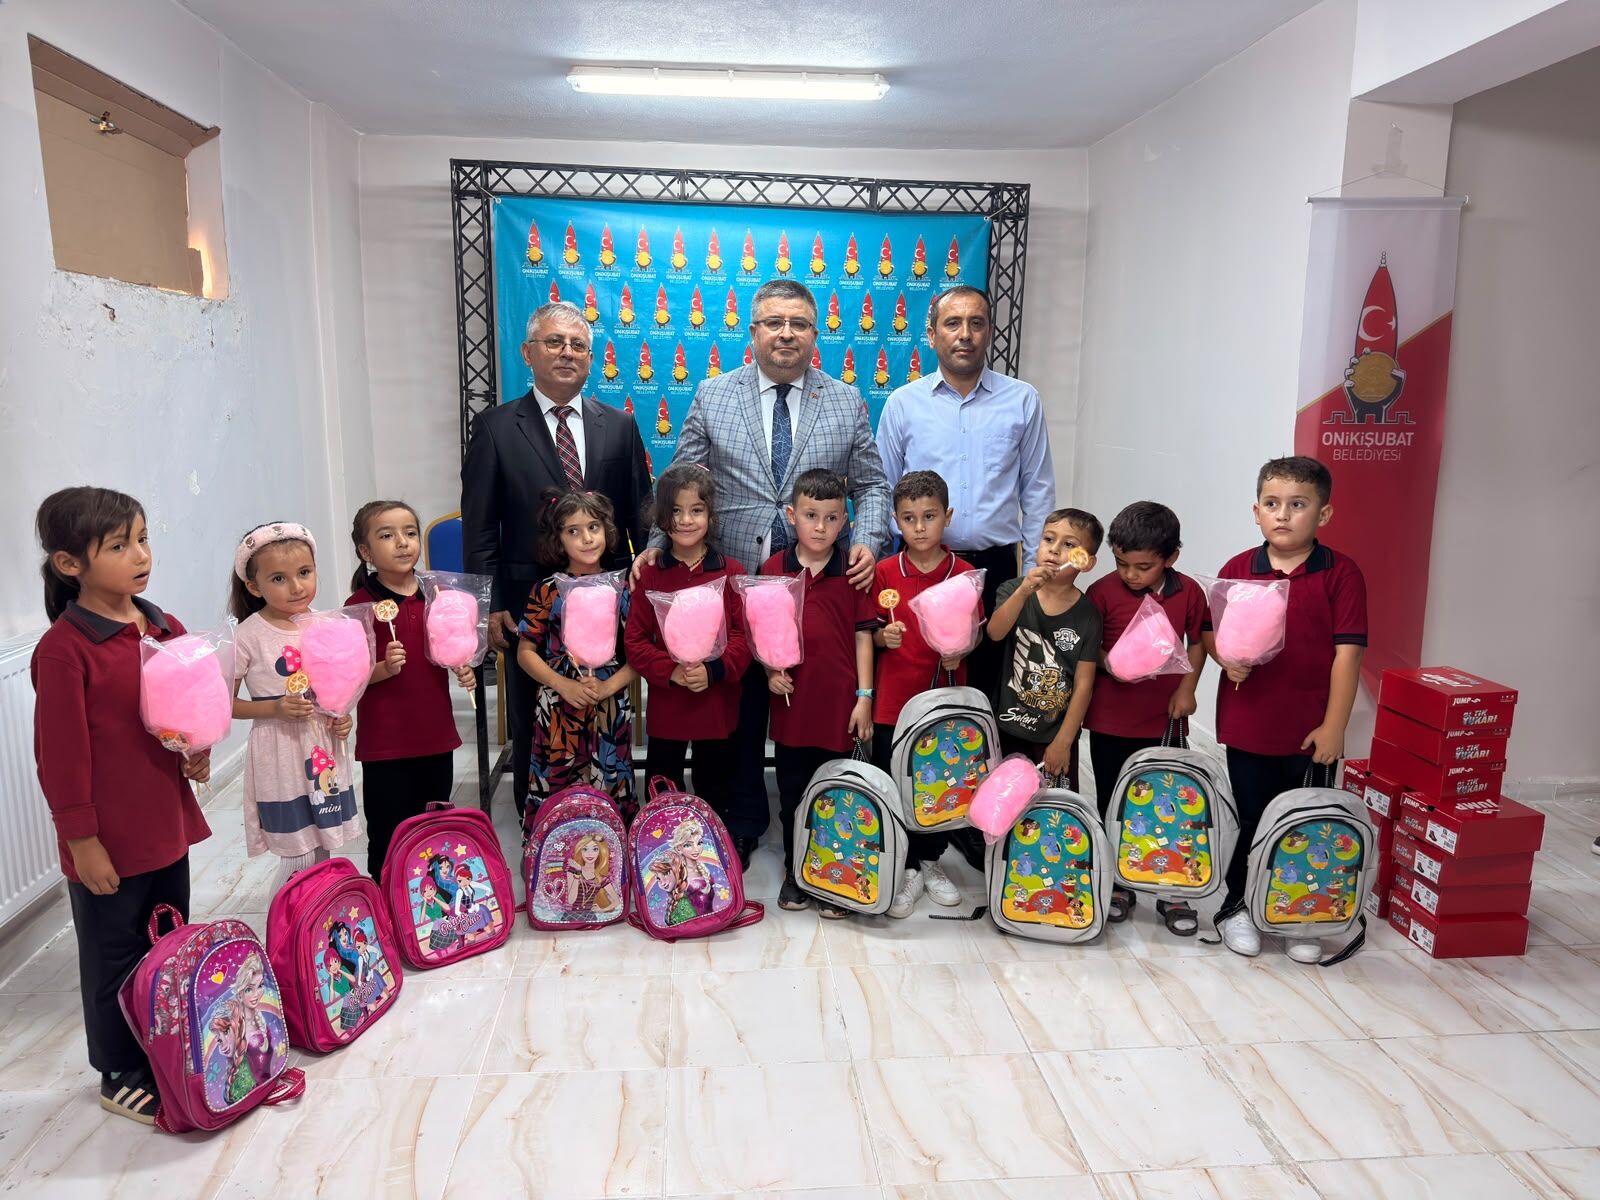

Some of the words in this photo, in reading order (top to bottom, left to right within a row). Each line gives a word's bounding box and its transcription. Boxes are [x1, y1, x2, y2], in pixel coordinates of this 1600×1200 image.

[1053, 628, 1081, 645] PAW
[1452, 697, 1472, 706] JUMP
[1446, 730, 1465, 739] JUMP
[1447, 767, 1465, 776] JUMP
